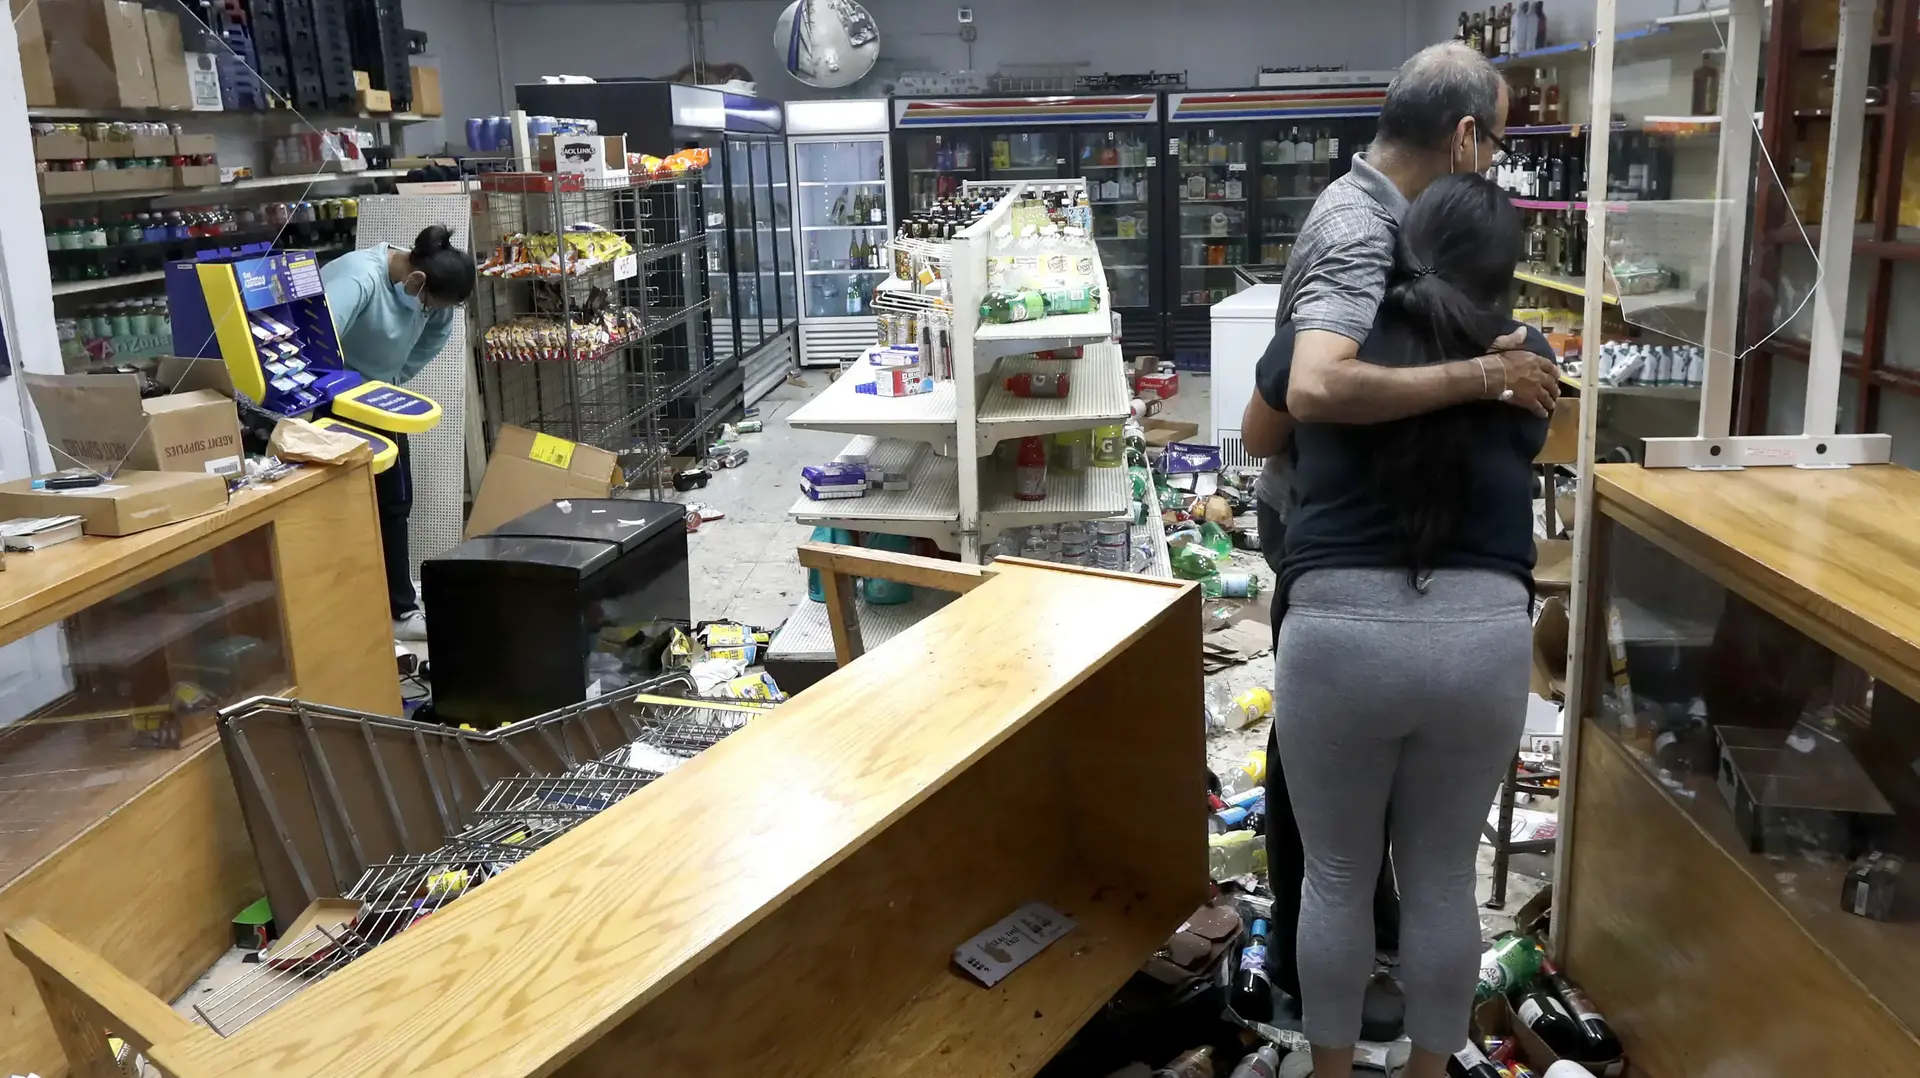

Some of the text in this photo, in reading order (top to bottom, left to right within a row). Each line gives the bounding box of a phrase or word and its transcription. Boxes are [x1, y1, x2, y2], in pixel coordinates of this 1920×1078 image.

[165, 434, 234, 458] AGENT SUPPLIES
[1101, 439, 1113, 453] G
[1005, 936, 1020, 947] END
